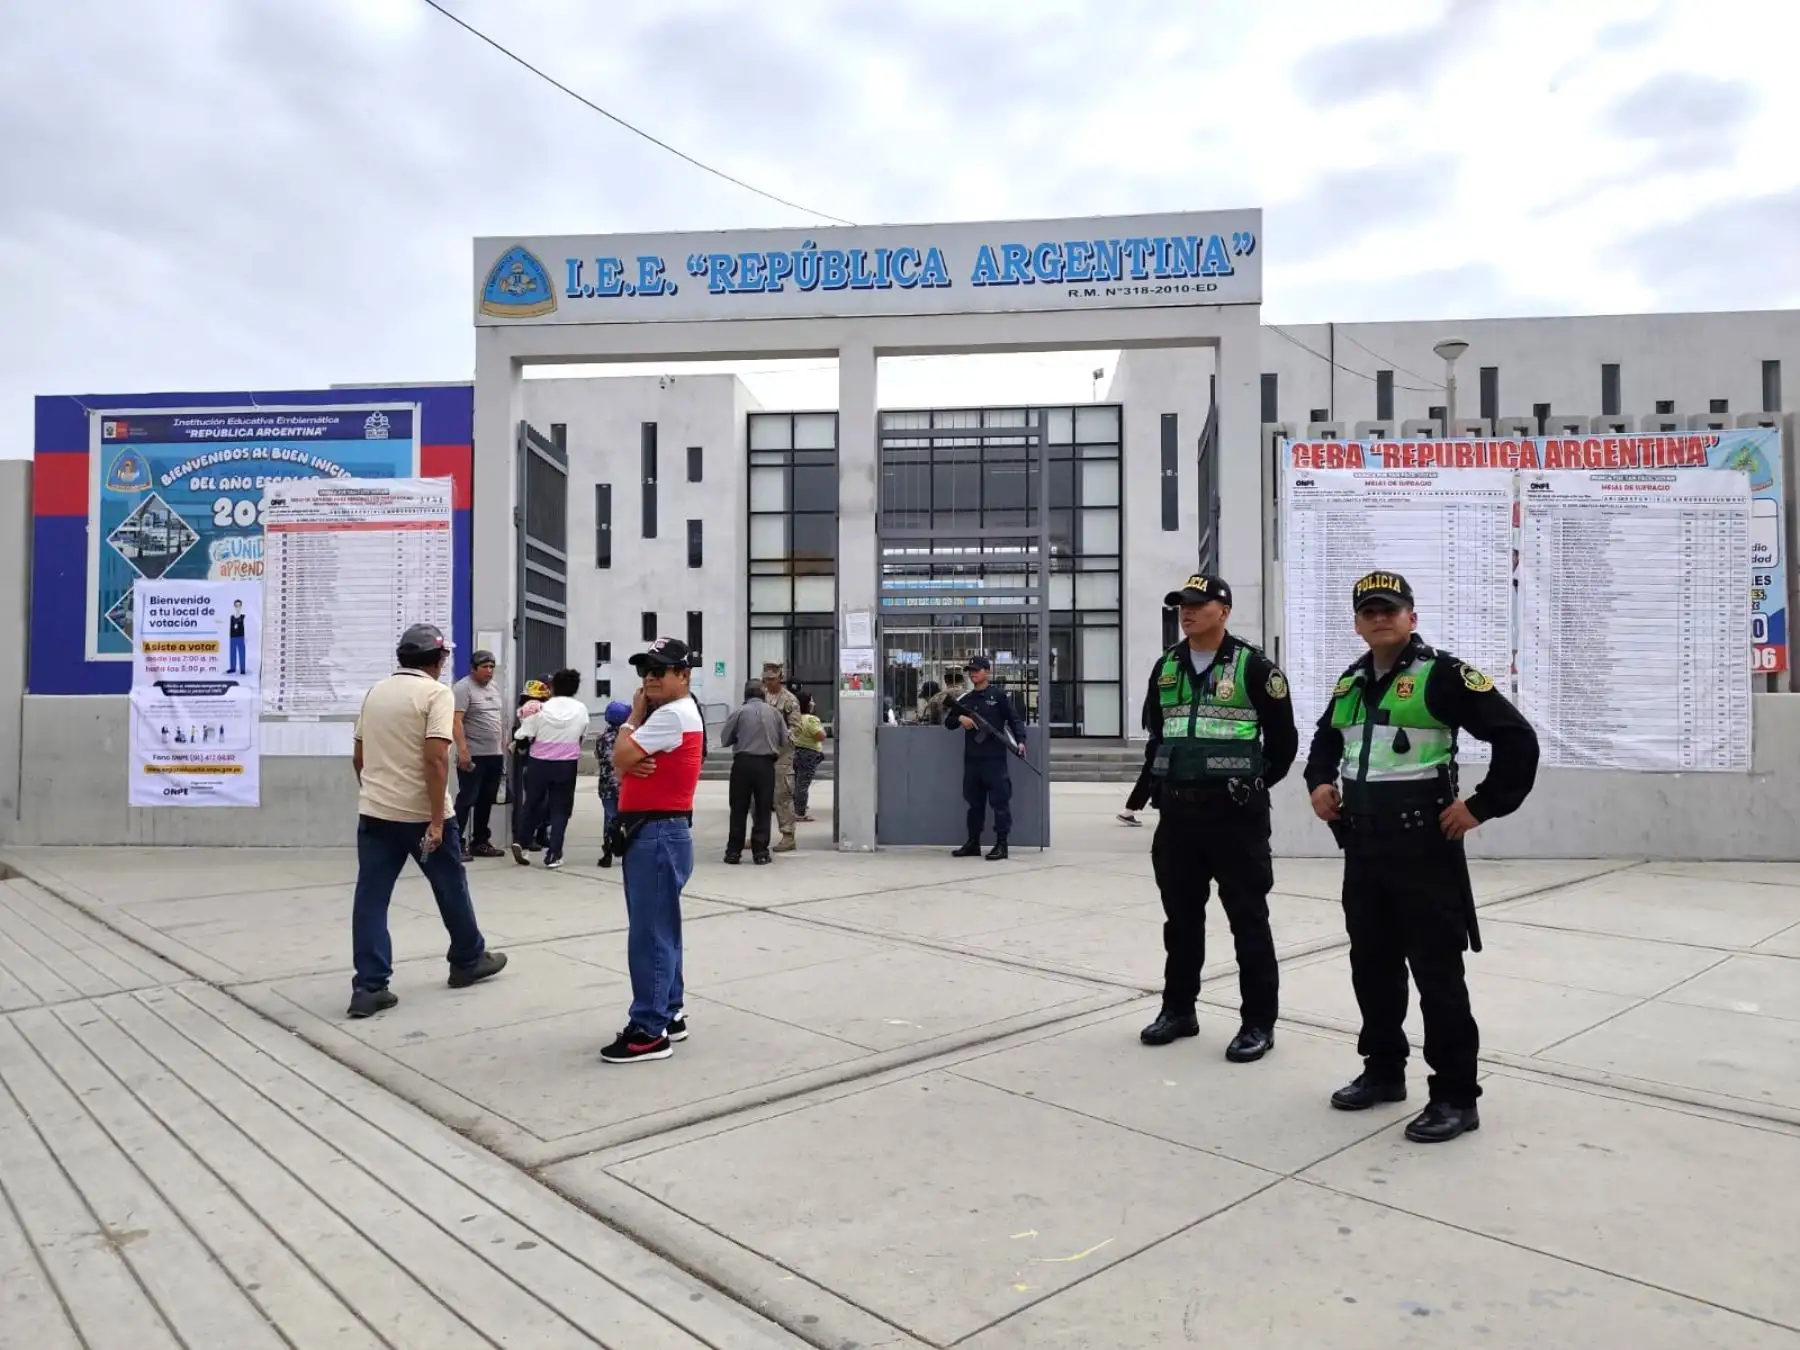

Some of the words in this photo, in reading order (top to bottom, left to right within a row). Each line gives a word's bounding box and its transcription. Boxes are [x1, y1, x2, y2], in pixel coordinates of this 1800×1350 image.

[565, 255, 678, 298] I.E.E.
[687, 240, 952, 294] “REPÚBLICA
[971, 232, 1256, 287] ARGENTINA”
[1068, 288, 1101, 298] R.M.
[1105, 283, 1218, 297] N°318-2010-ED
[173, 417, 225, 427] Institución
[227, 415, 274, 426] Educativa
[276, 415, 340, 425] Emblemática
[1544, 433, 1720, 469] ARGENTINA”
[160, 448, 249, 486] BIENVENIDOS
[252, 447, 269, 459] AL
[271, 447, 309, 464] BUEN
[190, 476, 216, 491] DEL
[219, 475, 252, 491] AÑO
[1356, 574, 1402, 597] POLICIA
[149, 595, 211, 605] Bienvenido
[149, 608, 157, 616] a
[159, 607, 170, 616] tu
[172, 606, 199, 616] local
[201, 606, 215, 616] de
[149, 617, 198, 628] votación
[144, 643, 177, 651] Asiste
[188, 643, 216, 652] votar
[163, 787, 189, 796] ONPE
